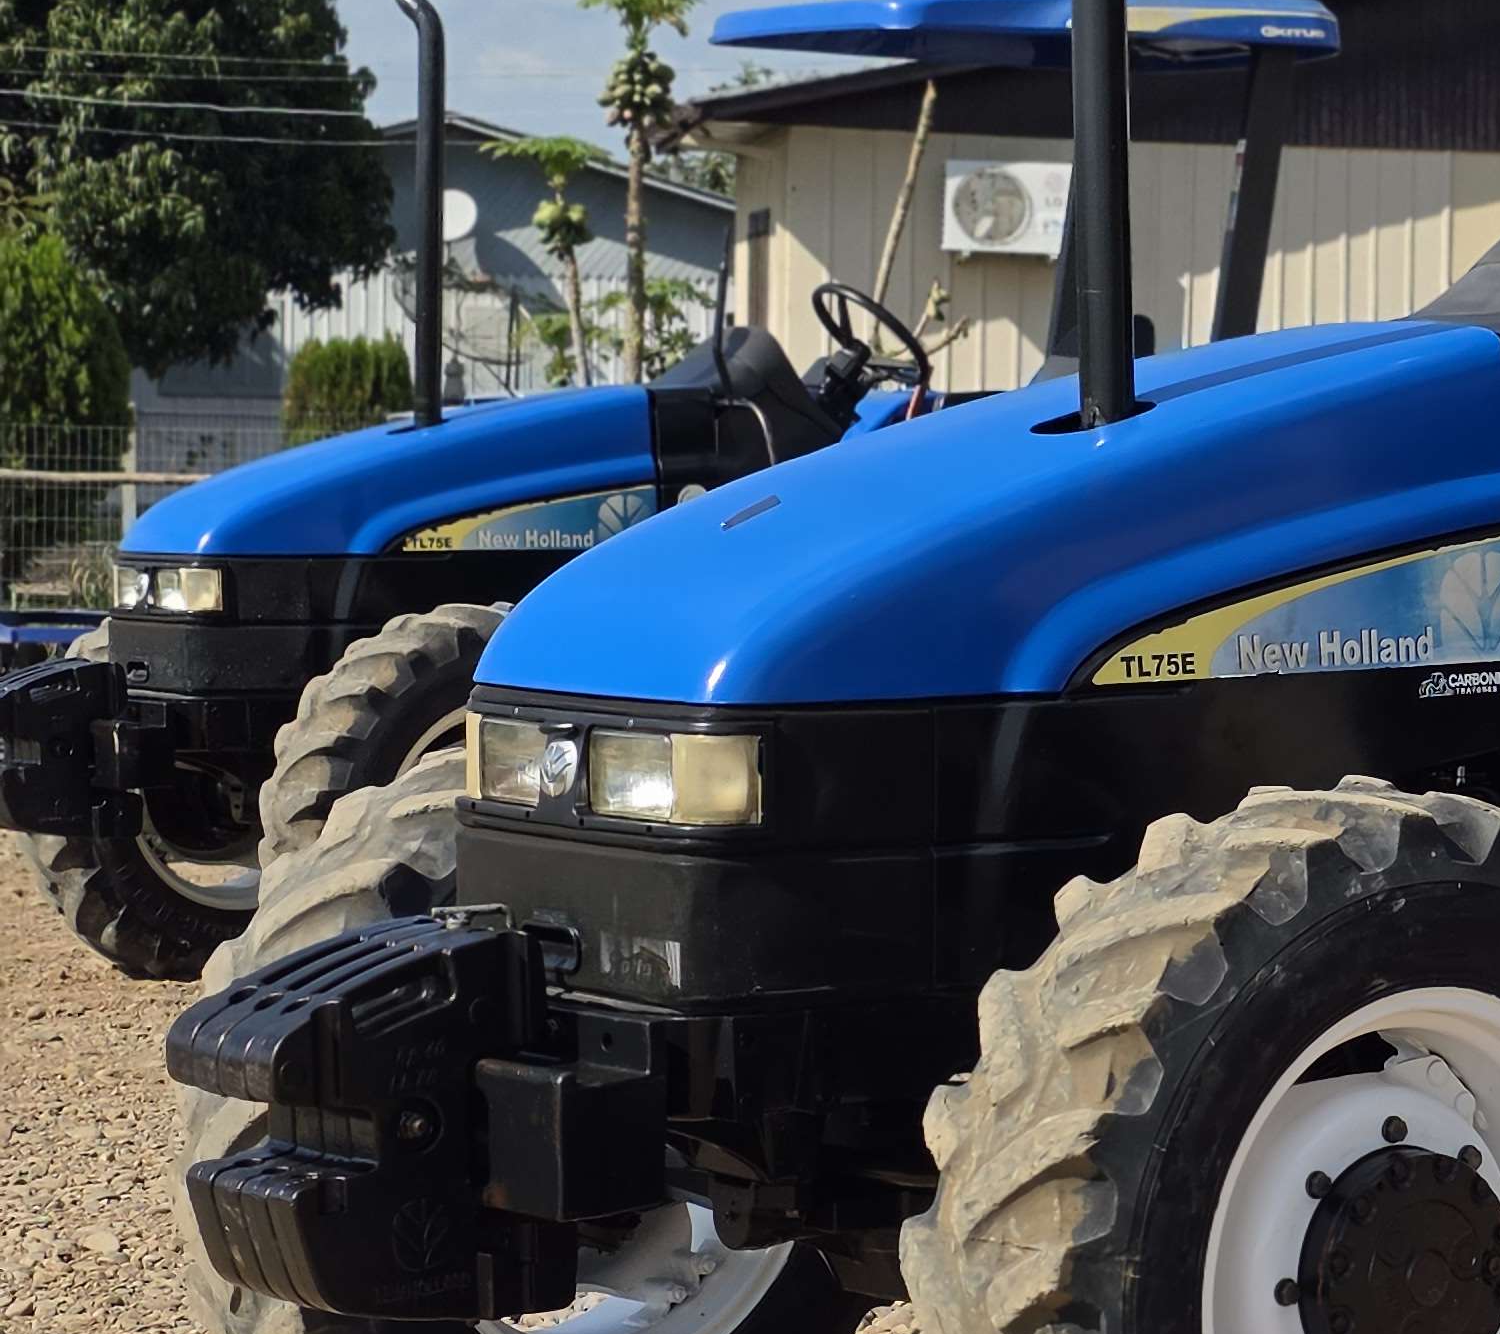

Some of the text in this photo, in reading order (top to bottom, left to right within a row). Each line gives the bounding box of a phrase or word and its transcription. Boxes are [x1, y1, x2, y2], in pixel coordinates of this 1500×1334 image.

[477, 530, 594, 548] New Holland
[1237, 626, 1434, 671] New Holland
[1120, 652, 1196, 678] TL75E
